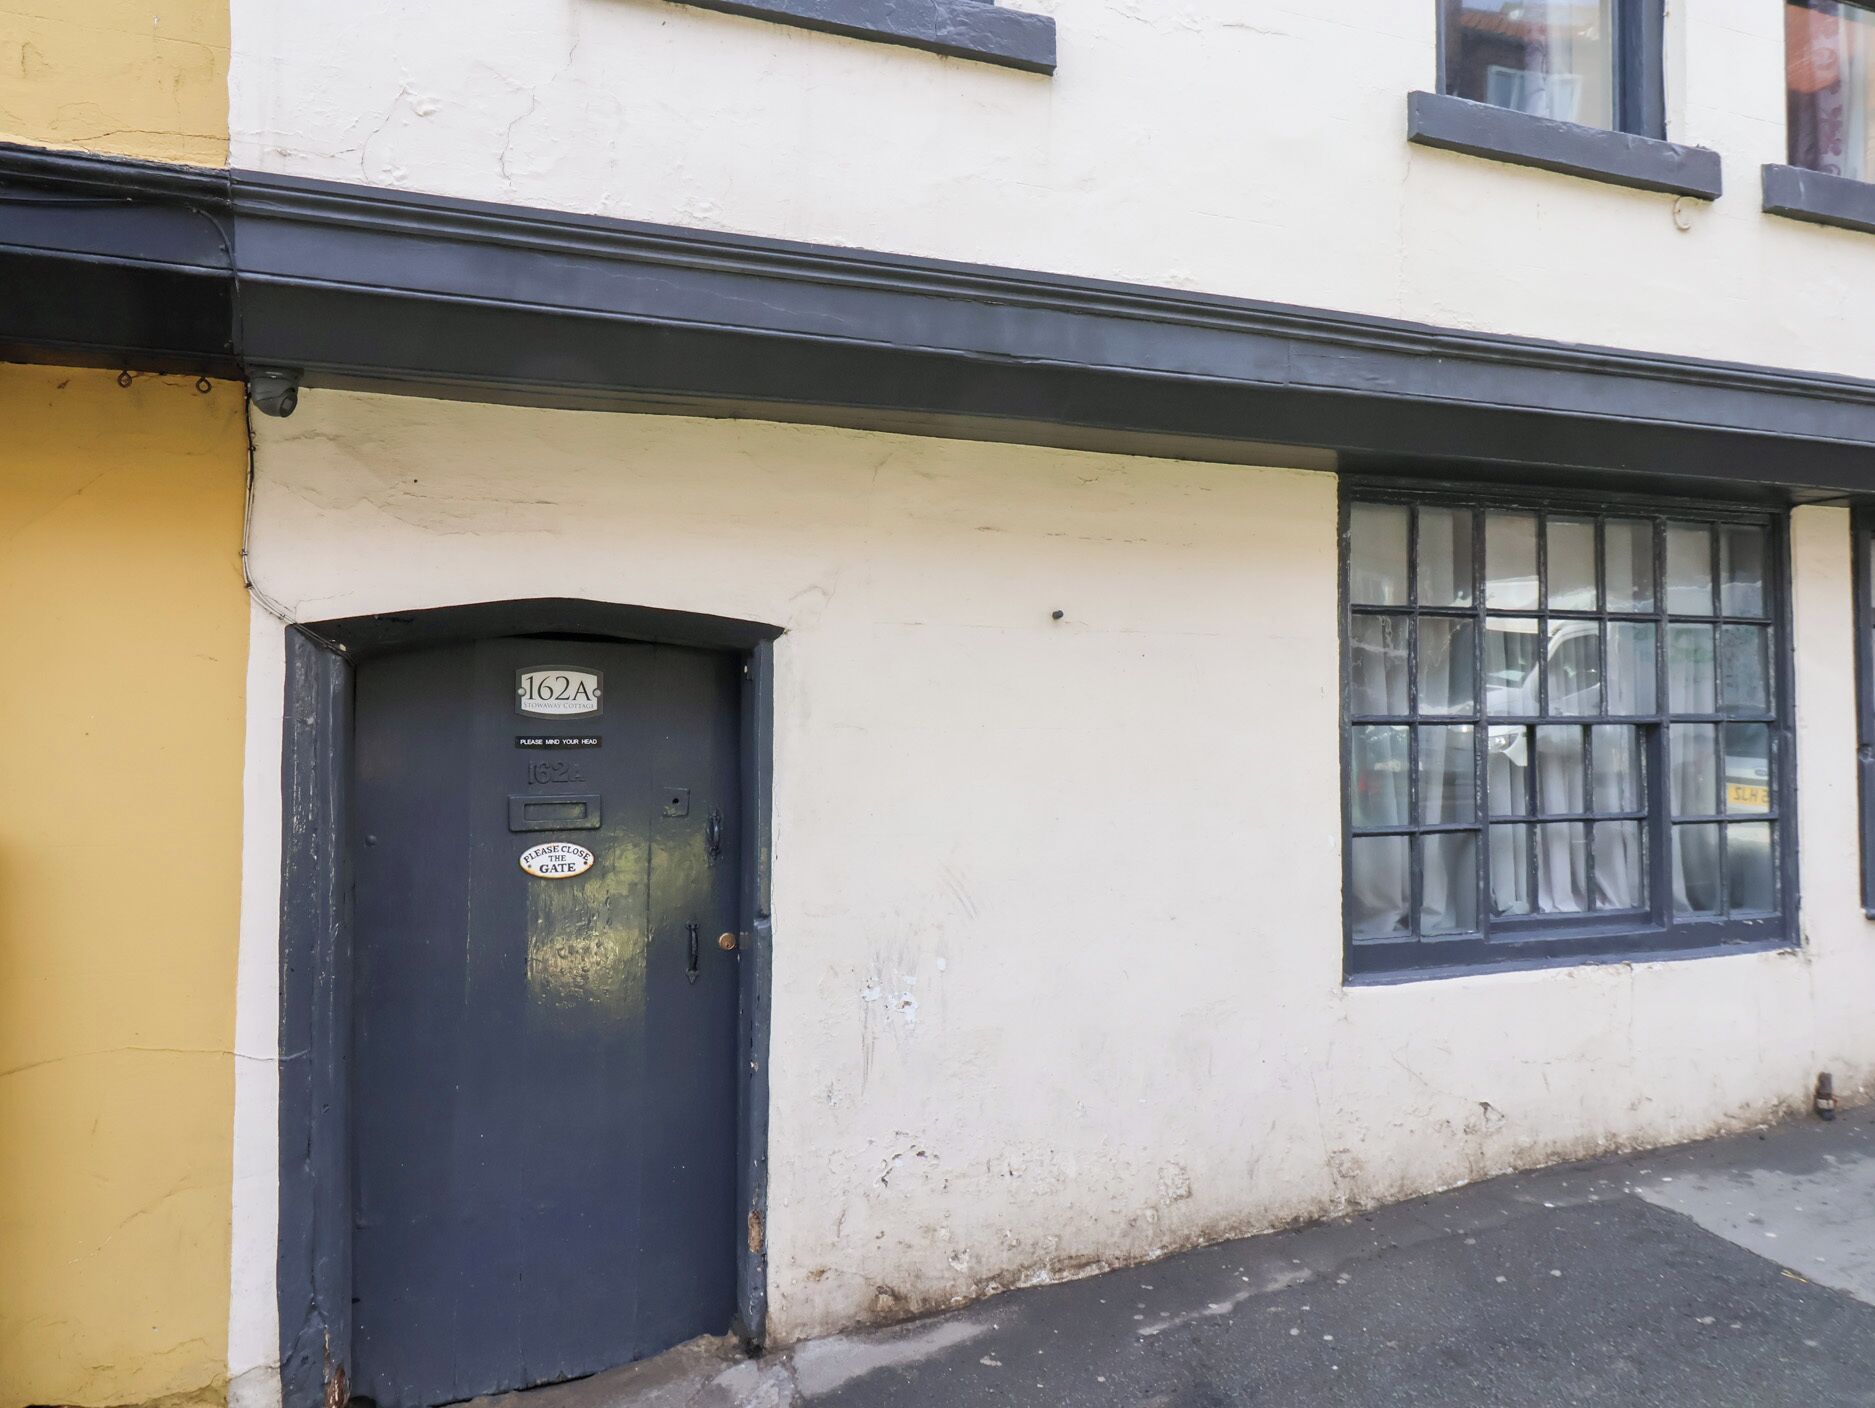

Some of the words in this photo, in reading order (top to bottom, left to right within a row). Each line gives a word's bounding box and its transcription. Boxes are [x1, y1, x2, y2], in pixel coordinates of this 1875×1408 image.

[526, 675, 592, 701] 162A
[523, 846, 559, 863] PLEASE
[561, 845, 591, 861] CLOSE
[539, 863, 576, 873] GATE
